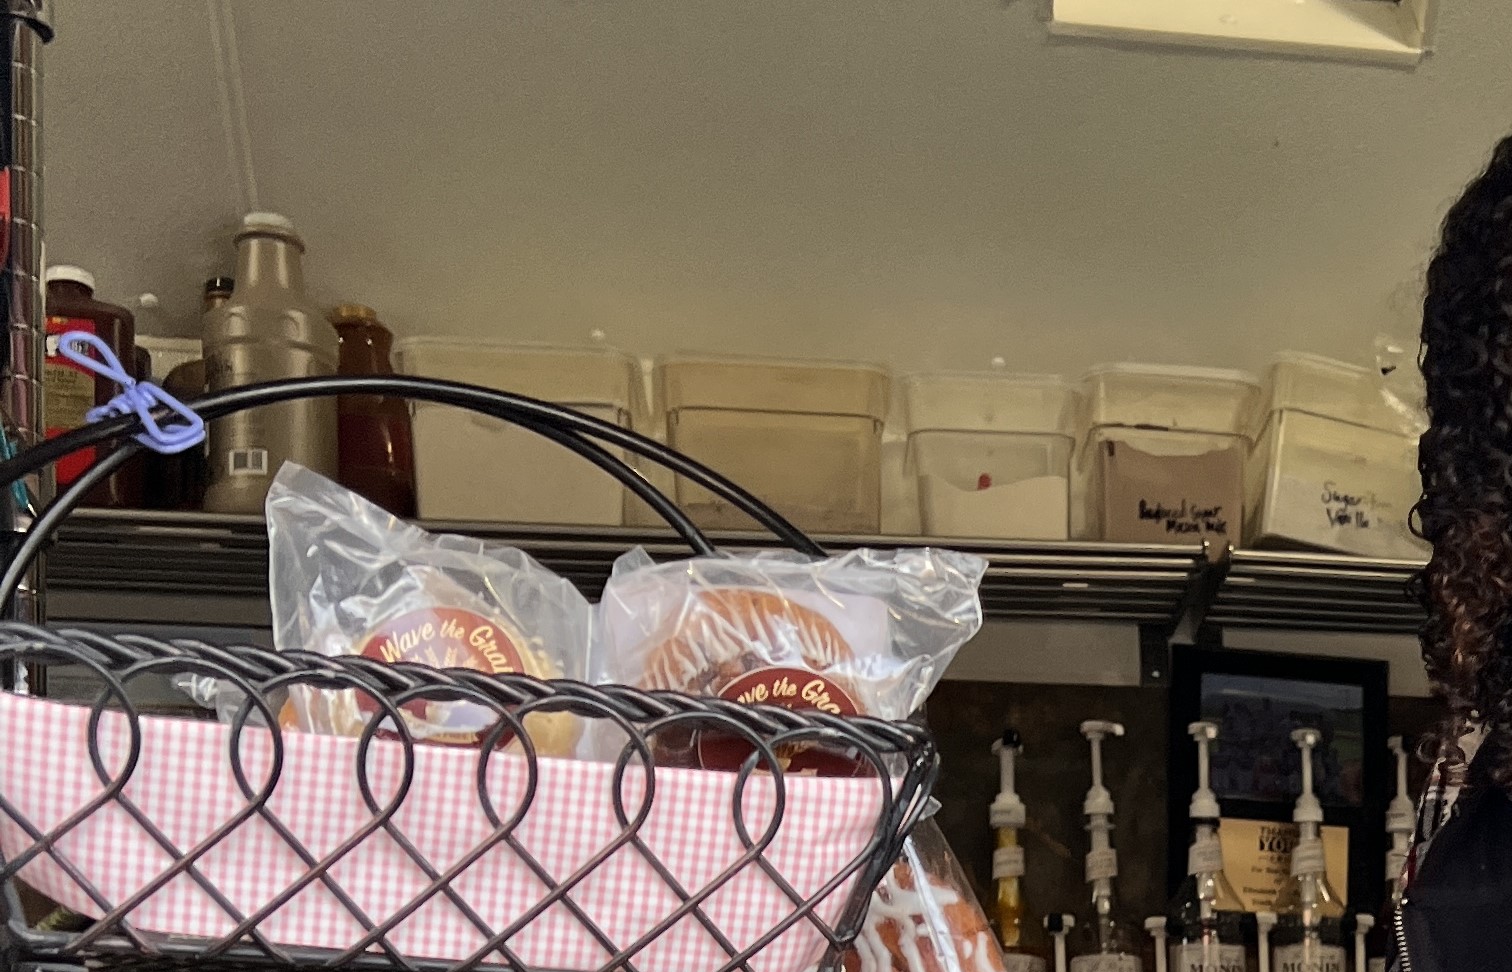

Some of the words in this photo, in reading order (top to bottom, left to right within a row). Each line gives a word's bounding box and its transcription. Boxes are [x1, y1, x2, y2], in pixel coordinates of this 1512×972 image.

[380, 621, 436, 664] Wave
[439, 618, 466, 640] the
[772, 676, 798, 698] the
